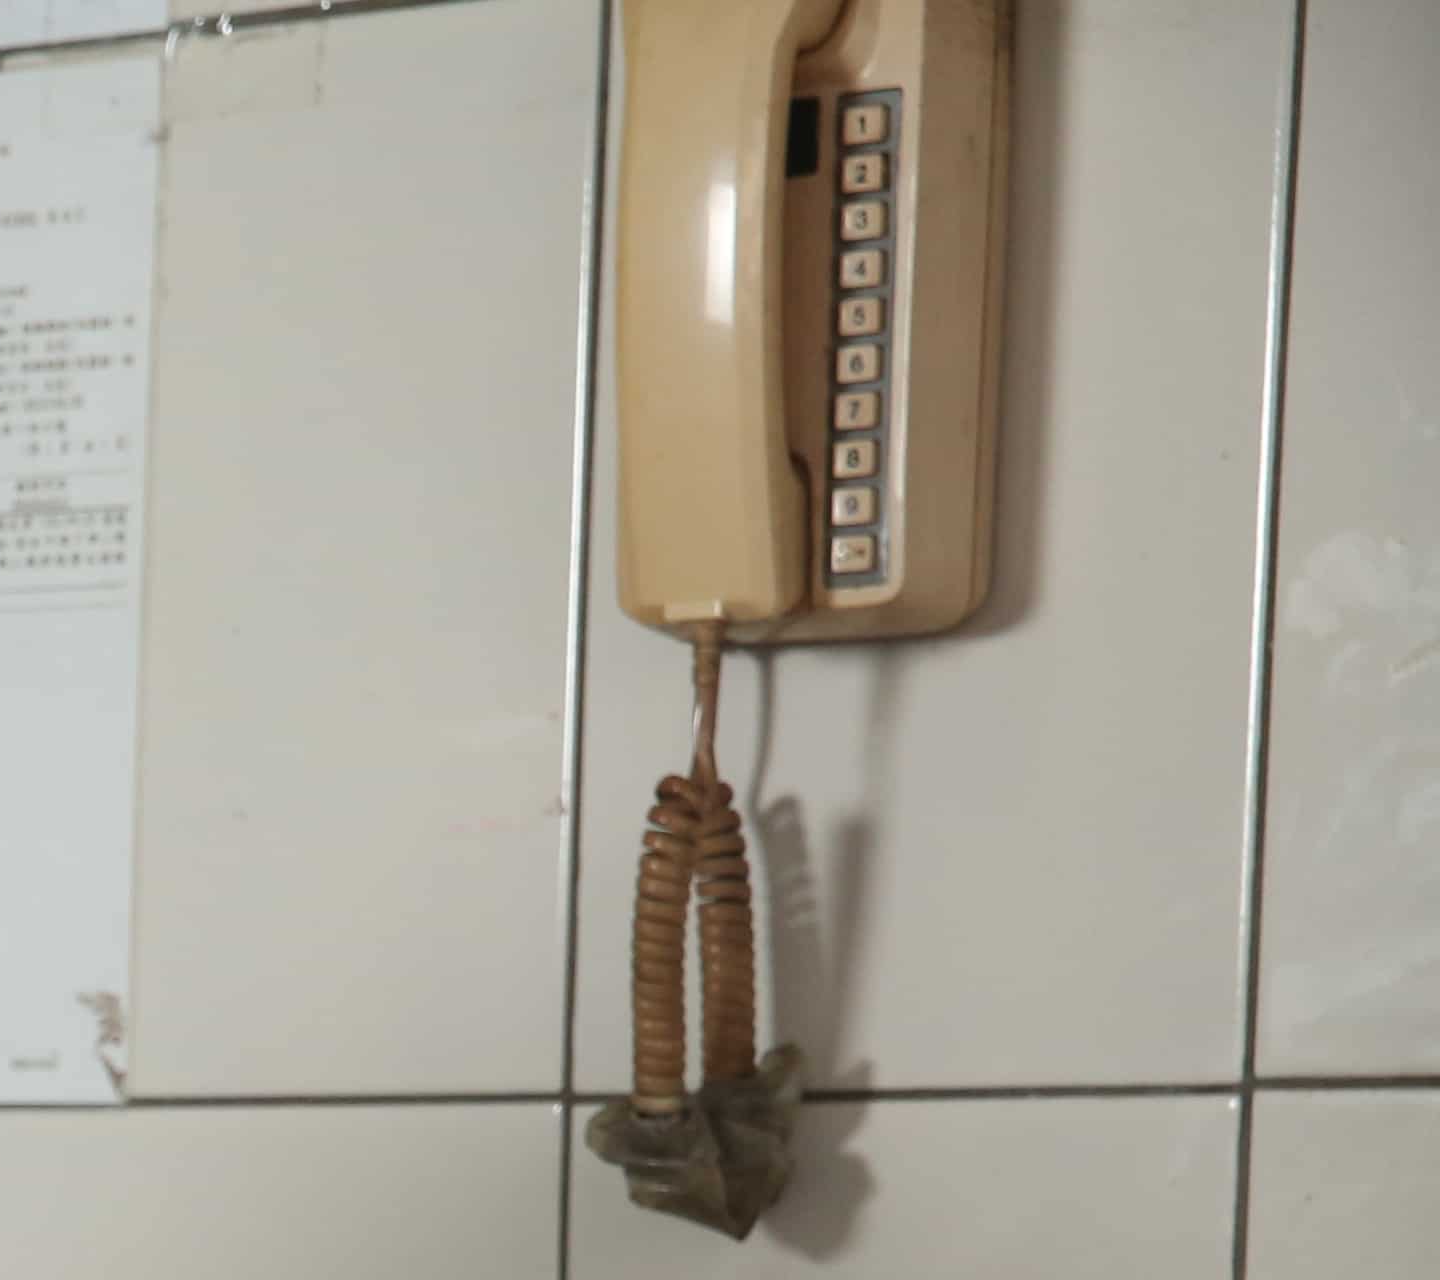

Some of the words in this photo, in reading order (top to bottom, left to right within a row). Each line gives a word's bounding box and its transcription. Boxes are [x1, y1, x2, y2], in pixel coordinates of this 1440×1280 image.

[856, 164, 867, 184] 2
[856, 210, 868, 229] 3
[854, 260, 867, 277] 4
[853, 306, 865, 325] 5
[850, 354, 863, 372] 6
[849, 400, 861, 419] 7
[848, 448, 860, 467] 8
[847, 496, 859, 514] 9
